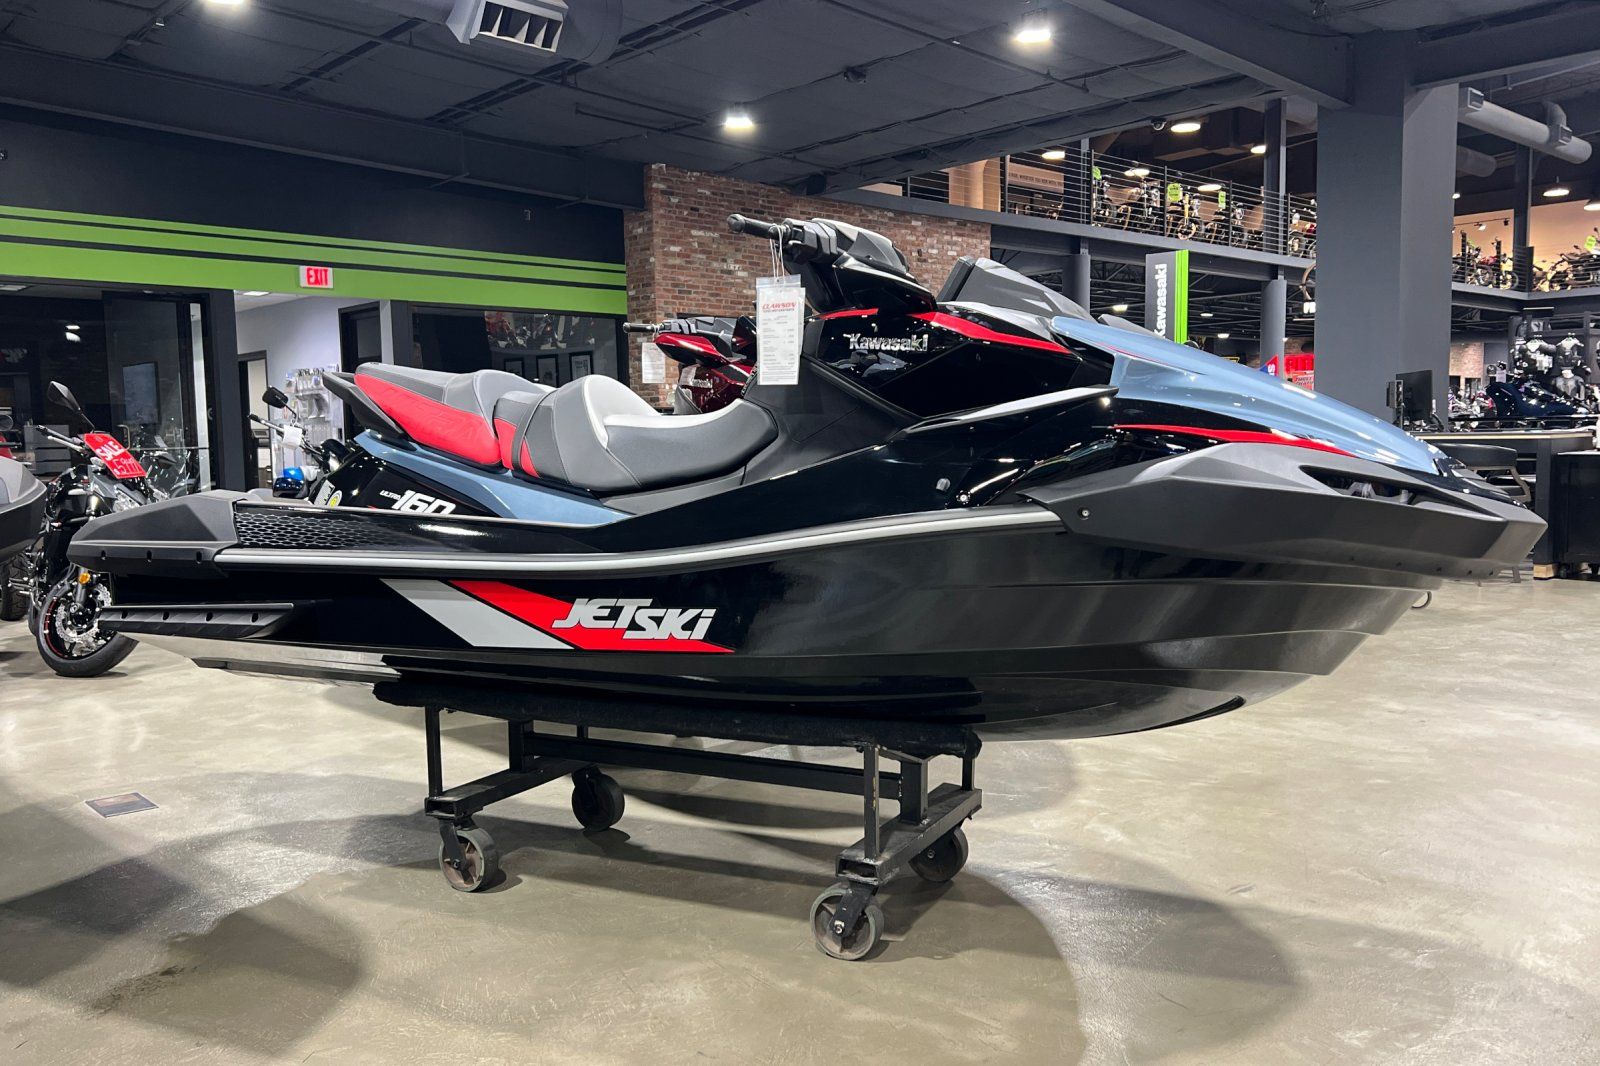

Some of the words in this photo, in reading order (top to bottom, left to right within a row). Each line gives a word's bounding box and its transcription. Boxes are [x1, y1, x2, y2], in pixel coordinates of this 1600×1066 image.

[306, 267, 329, 286] EXIT
[1154, 263, 1168, 338] Kawasaki
[848, 333, 929, 351] Kawasaki
[96, 441, 126, 461] SALE
[391, 489, 457, 515] 160
